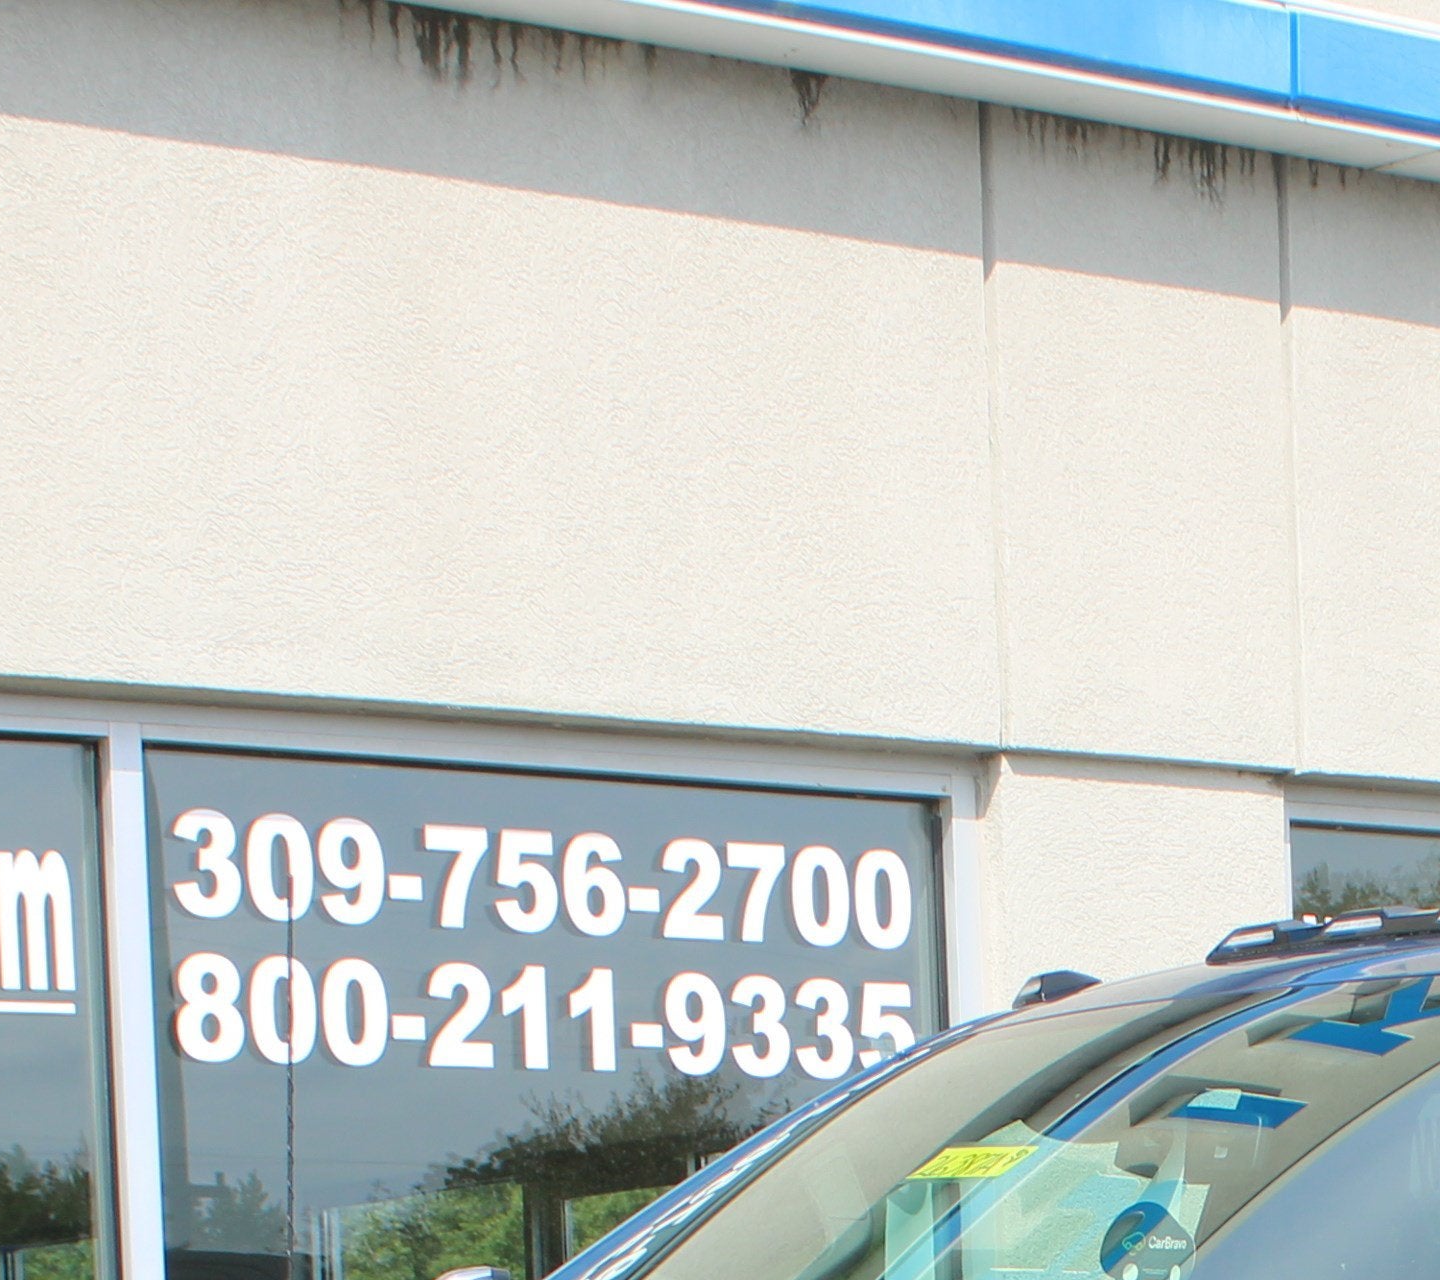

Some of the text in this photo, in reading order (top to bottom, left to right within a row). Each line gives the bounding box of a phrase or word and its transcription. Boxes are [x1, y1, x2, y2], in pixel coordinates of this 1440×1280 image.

[172, 809, 913, 952] 309-756-2700
[176, 953, 916, 1080] 800-211-9335
[1148, 1236, 1188, 1251] CarBravo
